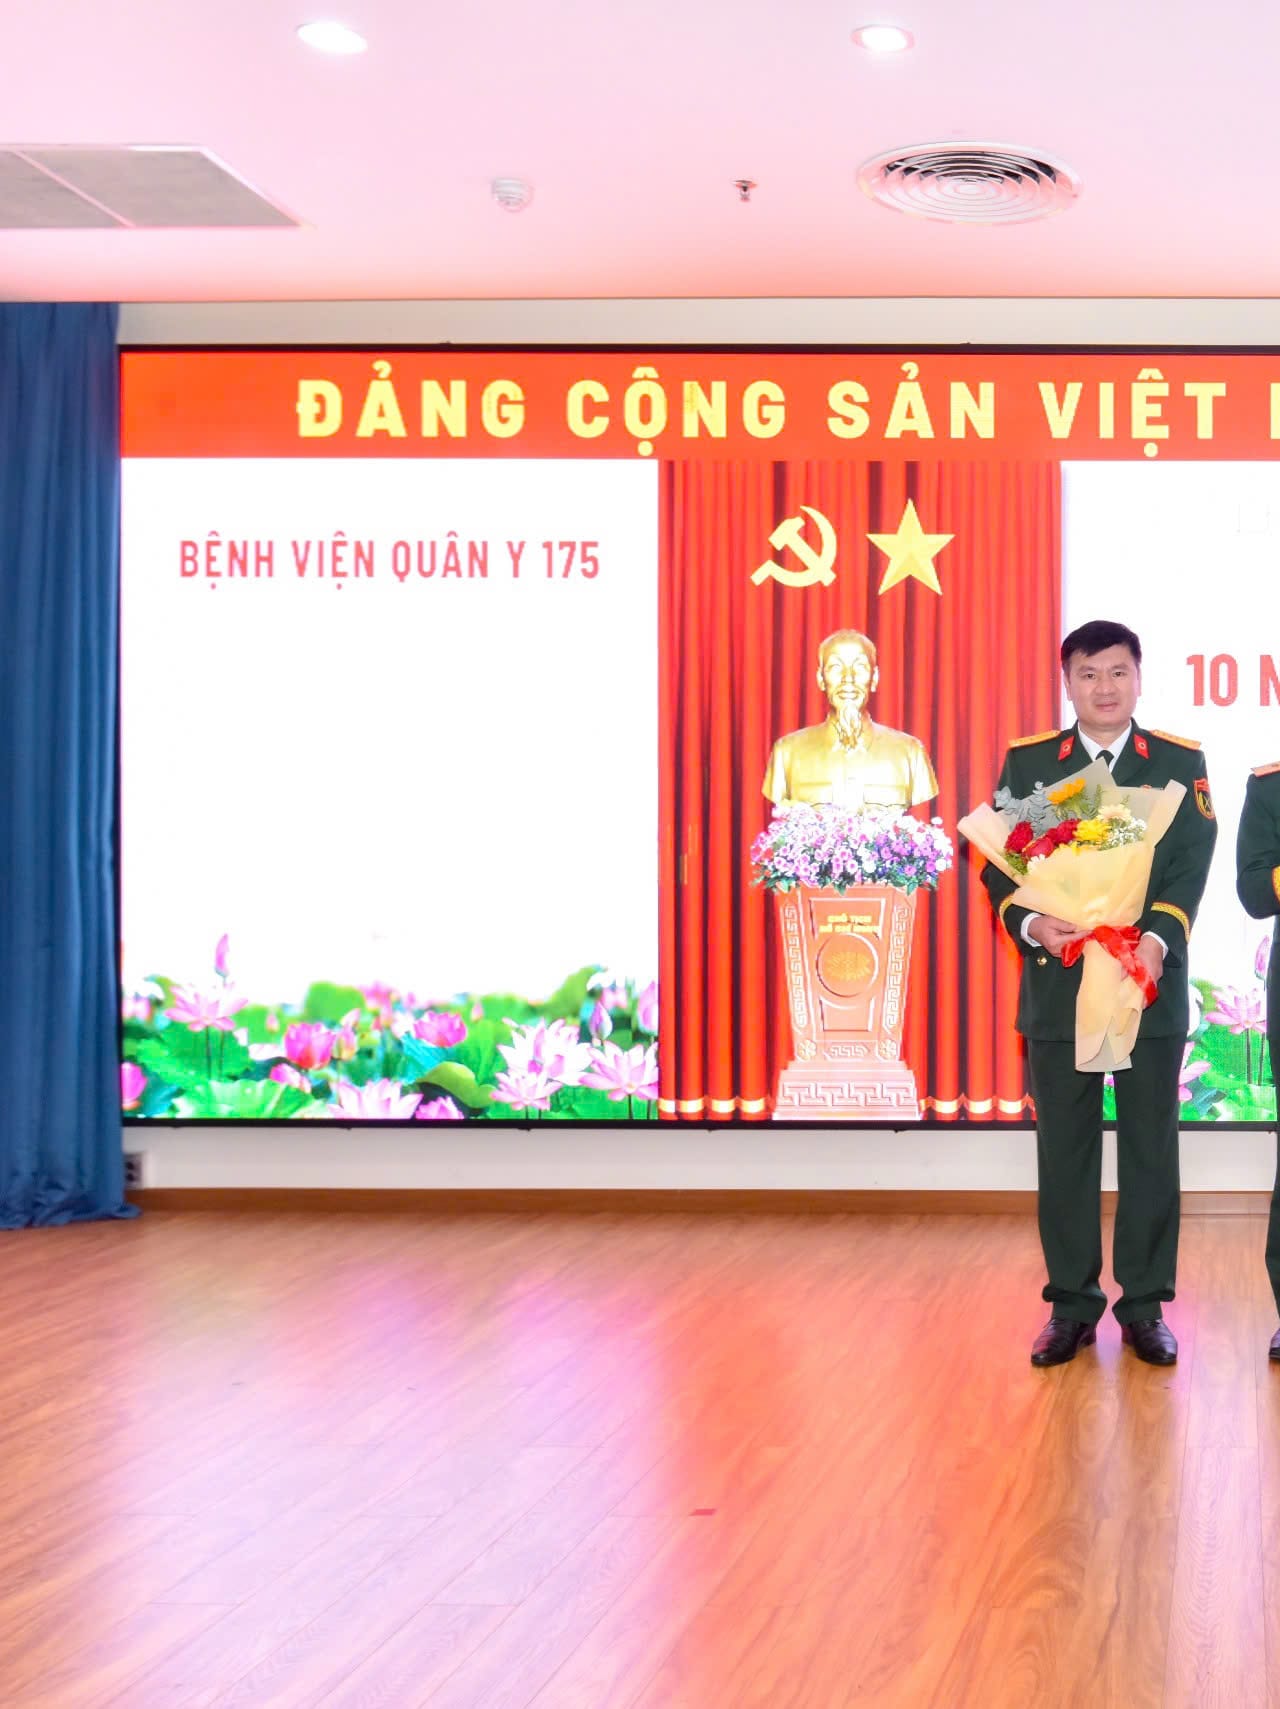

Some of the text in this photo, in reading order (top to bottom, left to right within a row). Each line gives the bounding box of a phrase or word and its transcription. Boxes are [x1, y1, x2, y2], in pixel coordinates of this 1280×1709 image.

[296, 360, 525, 439] ĐẢNG
[567, 366, 786, 457] CỘNG
[828, 361, 995, 439] SẢN
[1038, 367, 1227, 458] VIỆT
[179, 529, 601, 590] BỆNH VIỆN QUÂN Y 175
[1186, 653, 1239, 707] 10
